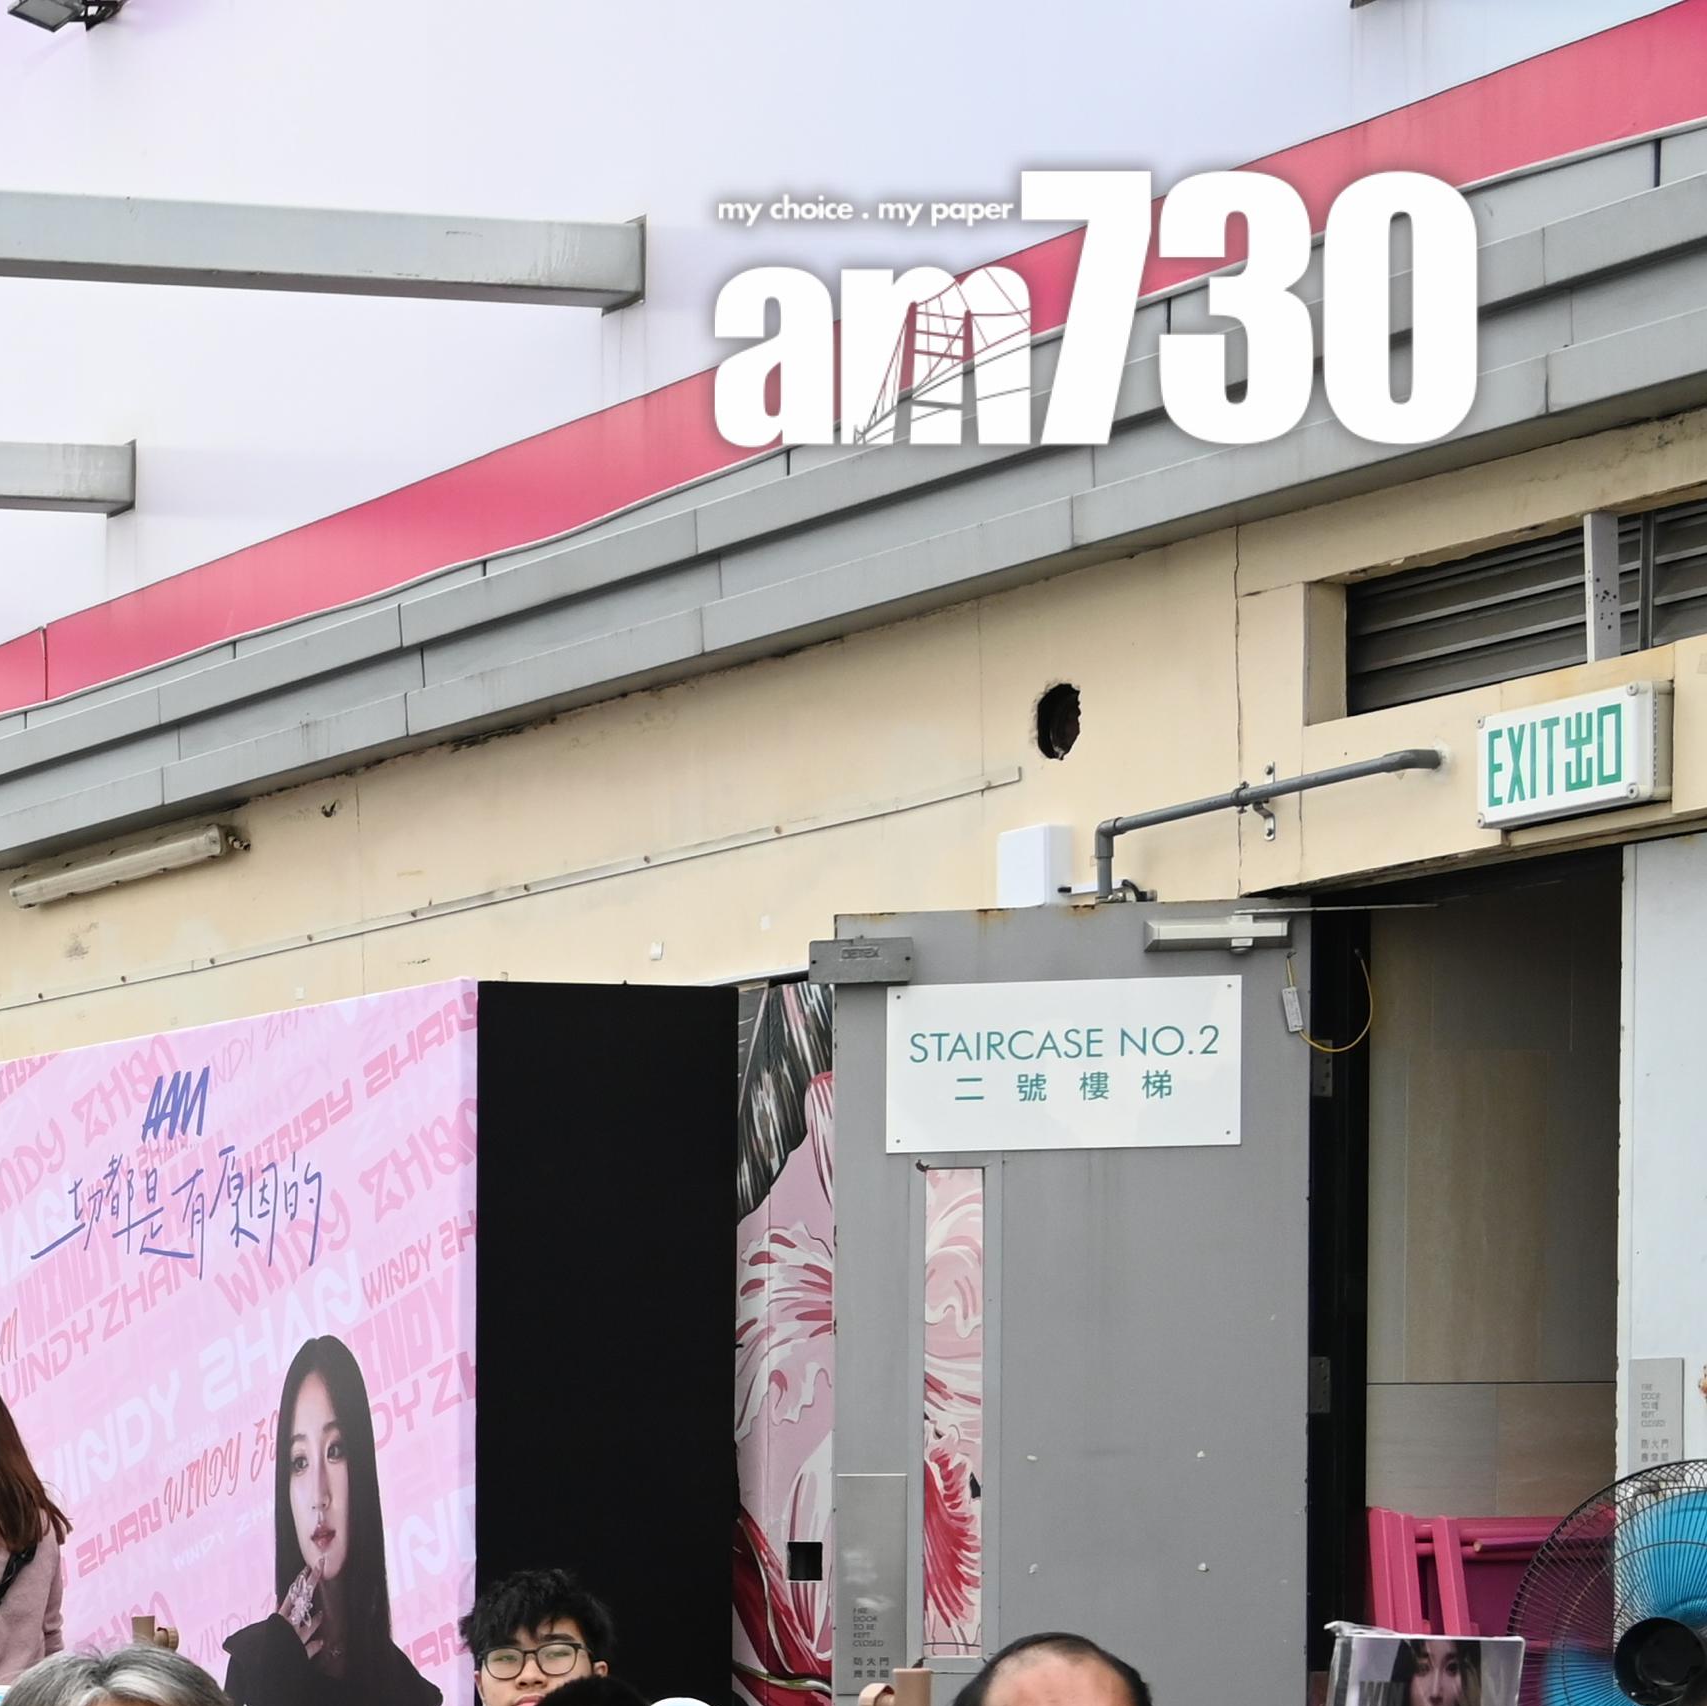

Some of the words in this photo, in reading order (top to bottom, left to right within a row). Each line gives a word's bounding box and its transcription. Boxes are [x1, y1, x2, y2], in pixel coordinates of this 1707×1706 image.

[1487, 717, 1563, 807] EXIT
[1565, 702, 1622, 792] 出口
[908, 1028, 1104, 1063] STAIRCASE
[1118, 1024, 1220, 1058] NO.2
[954, 1069, 1173, 1104] 二號樓梯
[30, 1145, 322, 1285] 一切都是有原因的
[362, 1233, 433, 1310] WINDY
